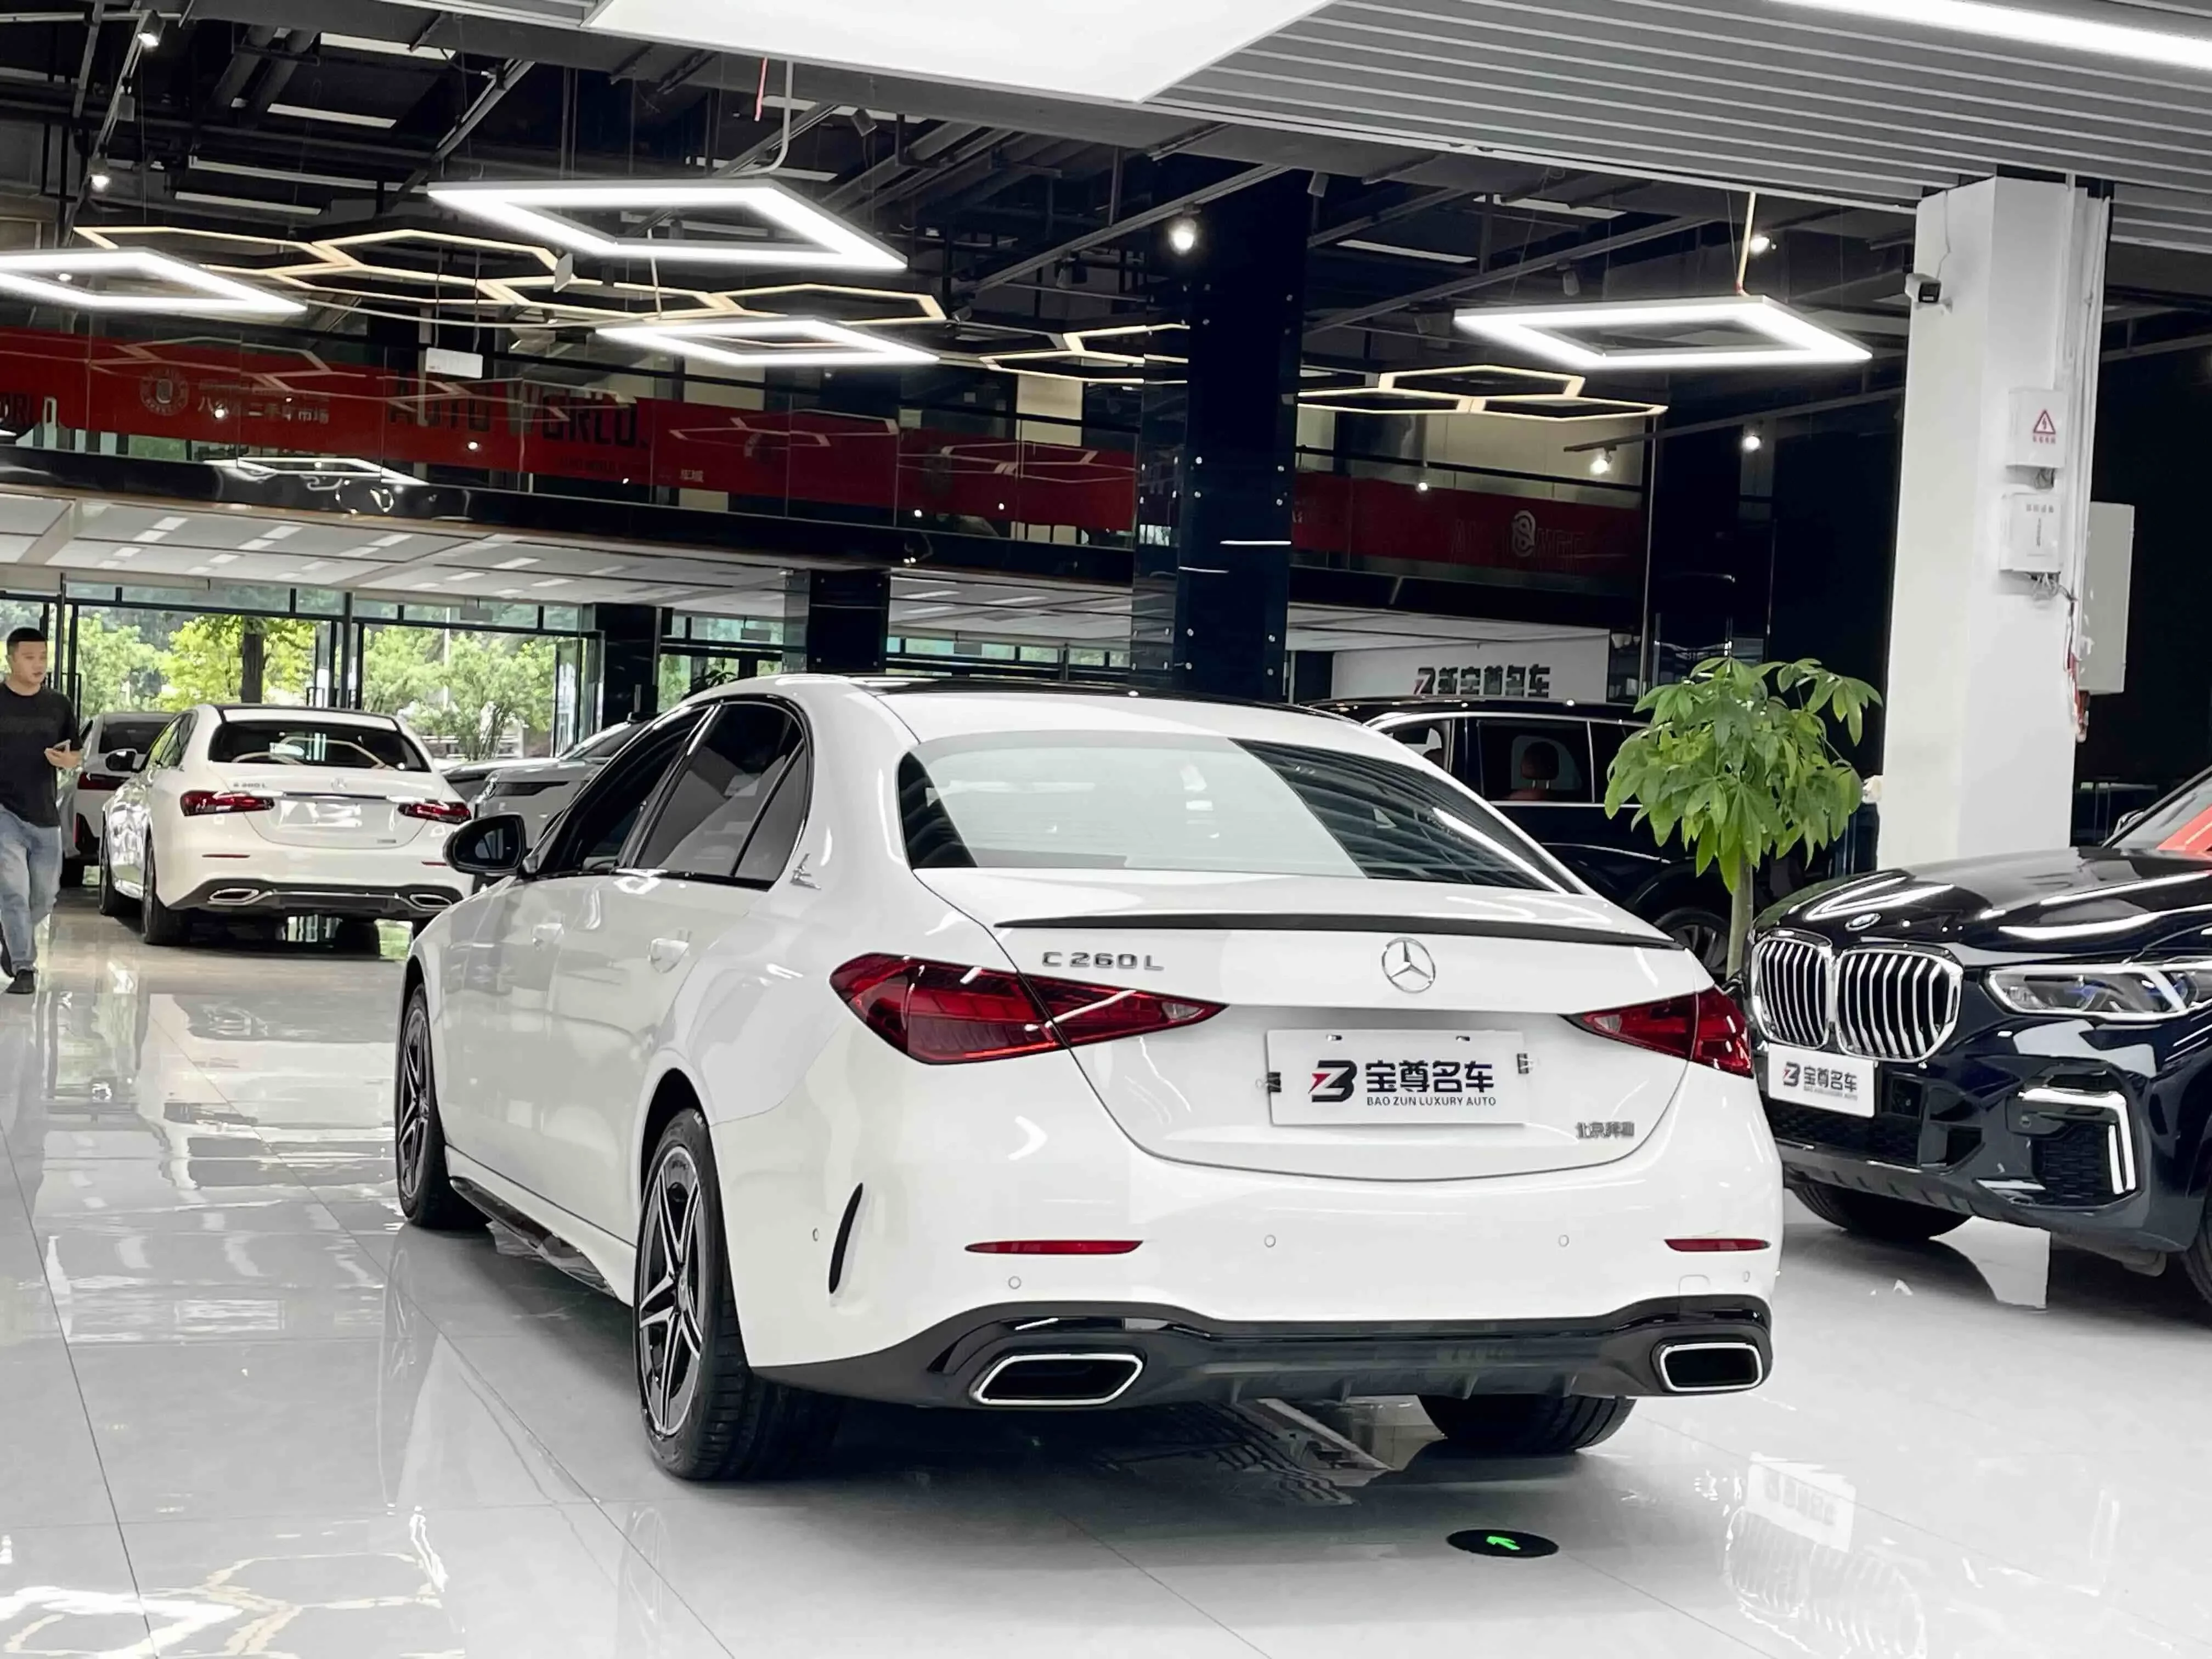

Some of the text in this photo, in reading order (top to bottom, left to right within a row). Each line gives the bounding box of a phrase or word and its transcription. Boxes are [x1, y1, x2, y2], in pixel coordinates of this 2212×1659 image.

[1042, 951, 1164, 971] C 260 L
[1365, 1059, 1495, 1093] 宝尊名车
[1804, 1064, 1858, 1092] 宝尊名车
[1367, 1097, 1497, 1106] BAO ZUN LUXURY AUTO
